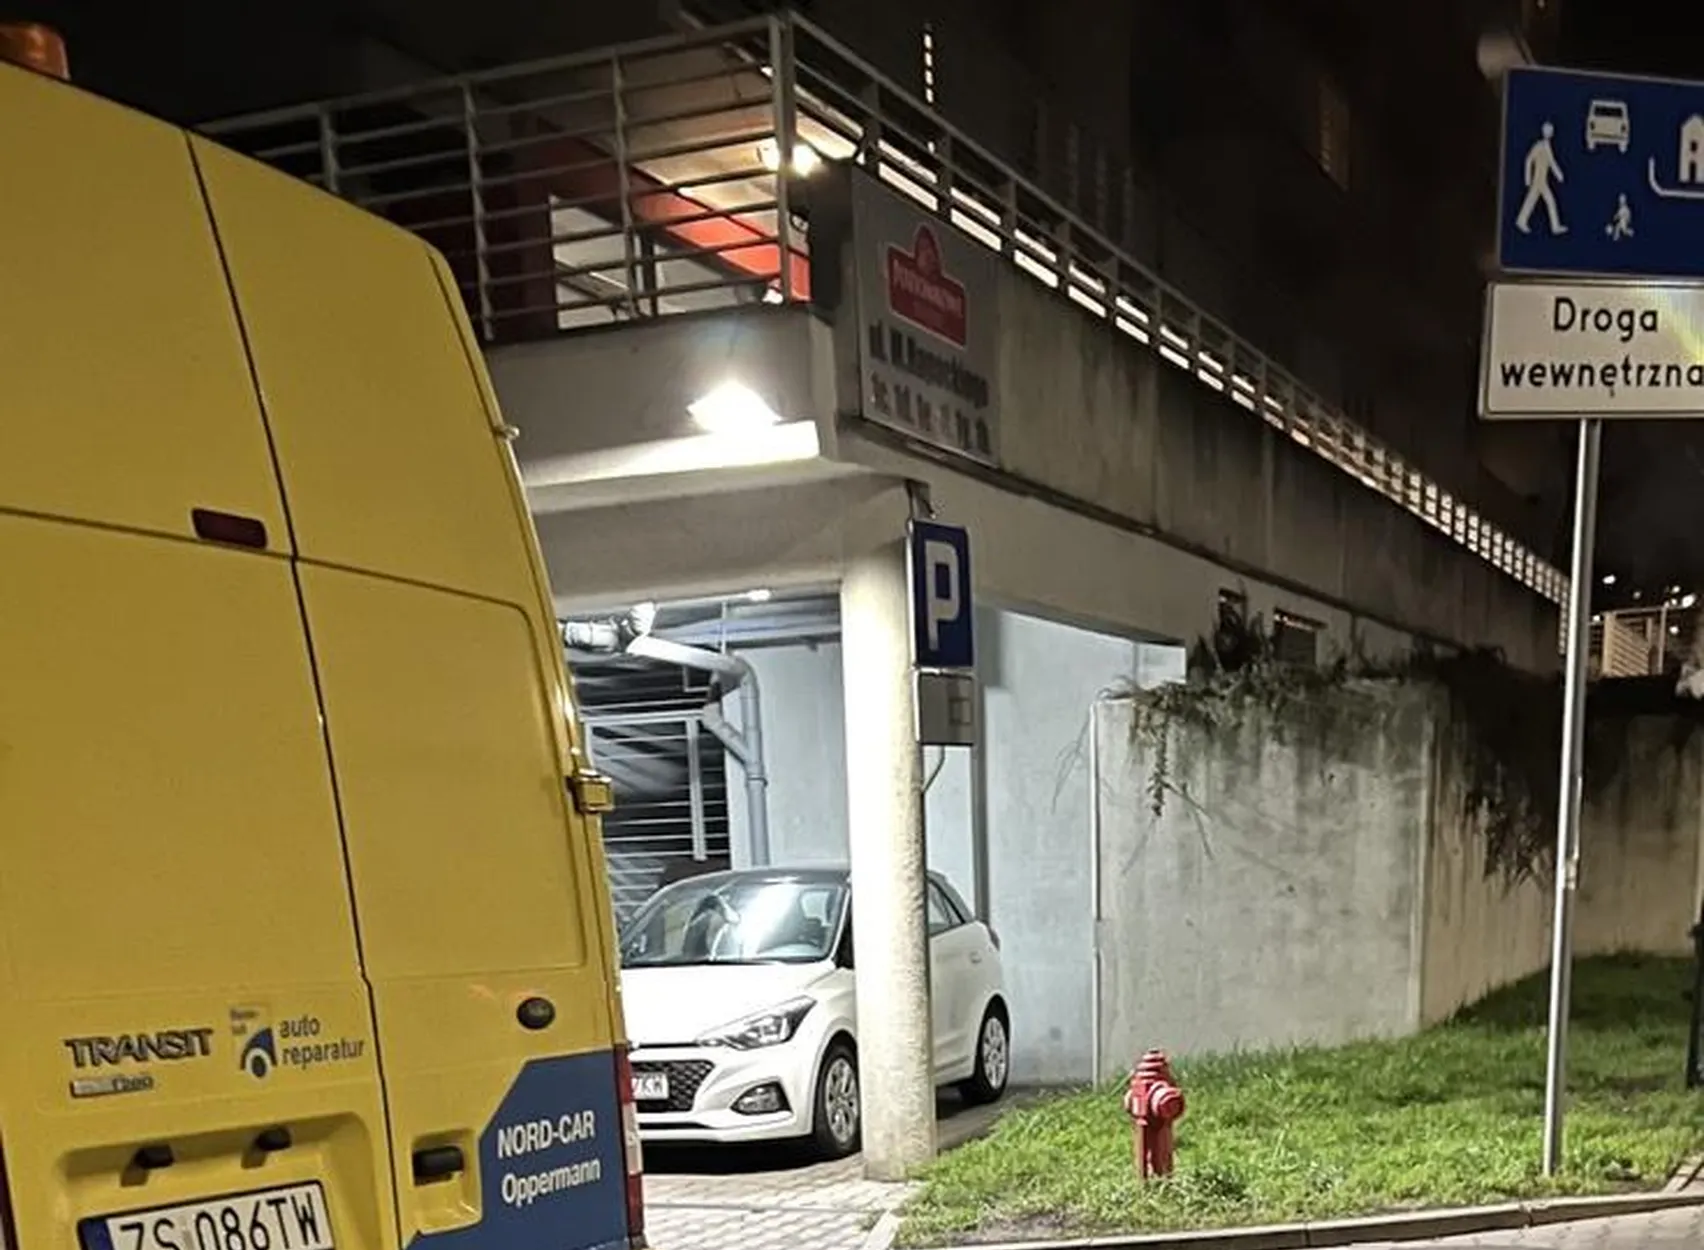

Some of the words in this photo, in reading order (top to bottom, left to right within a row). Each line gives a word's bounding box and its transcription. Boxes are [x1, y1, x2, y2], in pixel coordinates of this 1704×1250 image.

[1554, 297, 1658, 342] Droga
[1501, 353, 1704, 398] wewnętrzna
[925, 541, 960, 651] P
[65, 1028, 213, 1067] TRANSIT
[280, 1015, 320, 1038] auto
[282, 1039, 364, 1070] reparatur
[498, 1110, 595, 1158] NORD-CAR
[502, 1158, 600, 1208] Oppermann
